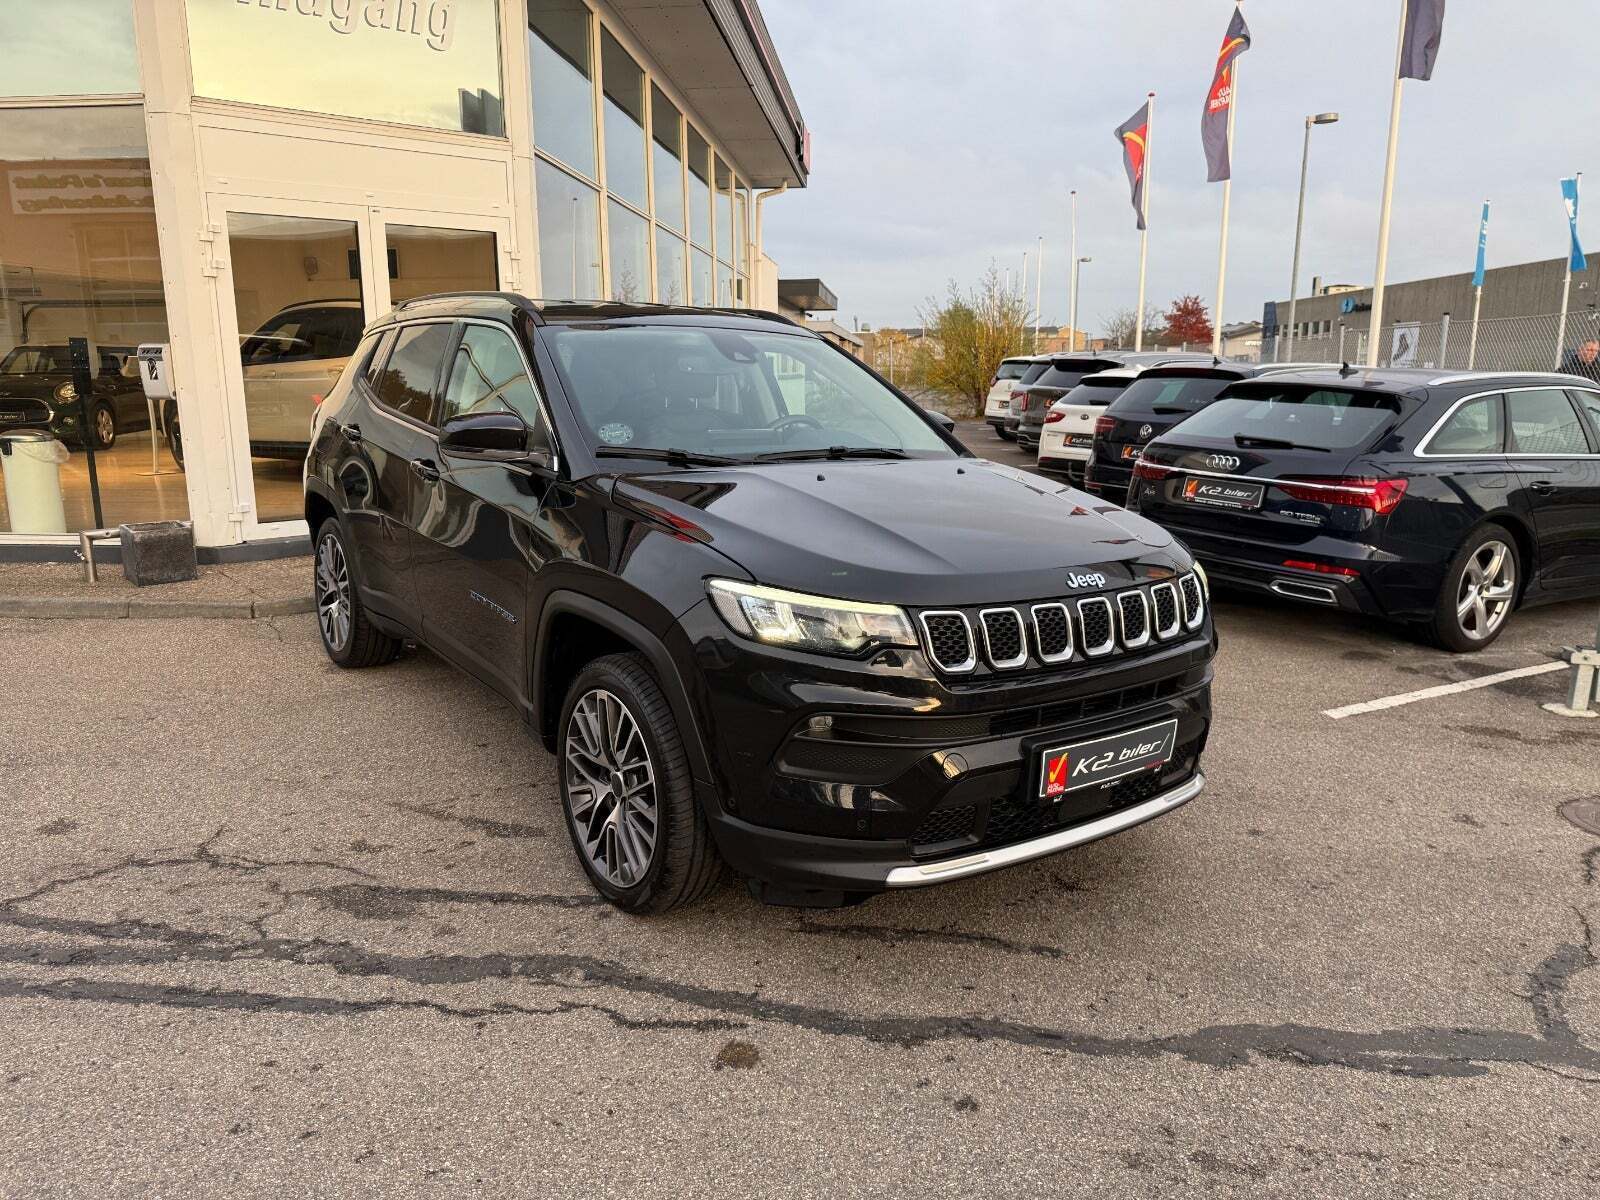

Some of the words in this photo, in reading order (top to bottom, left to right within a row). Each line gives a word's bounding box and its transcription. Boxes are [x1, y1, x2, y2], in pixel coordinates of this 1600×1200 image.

[236, 0, 453, 51] gang
[1198, 485, 1222, 495] K2
[1223, 488, 1250, 498] biler
[1066, 572, 1106, 588] Jeep
[1071, 751, 1115, 777] K2
[1118, 740, 1161, 761] biler
